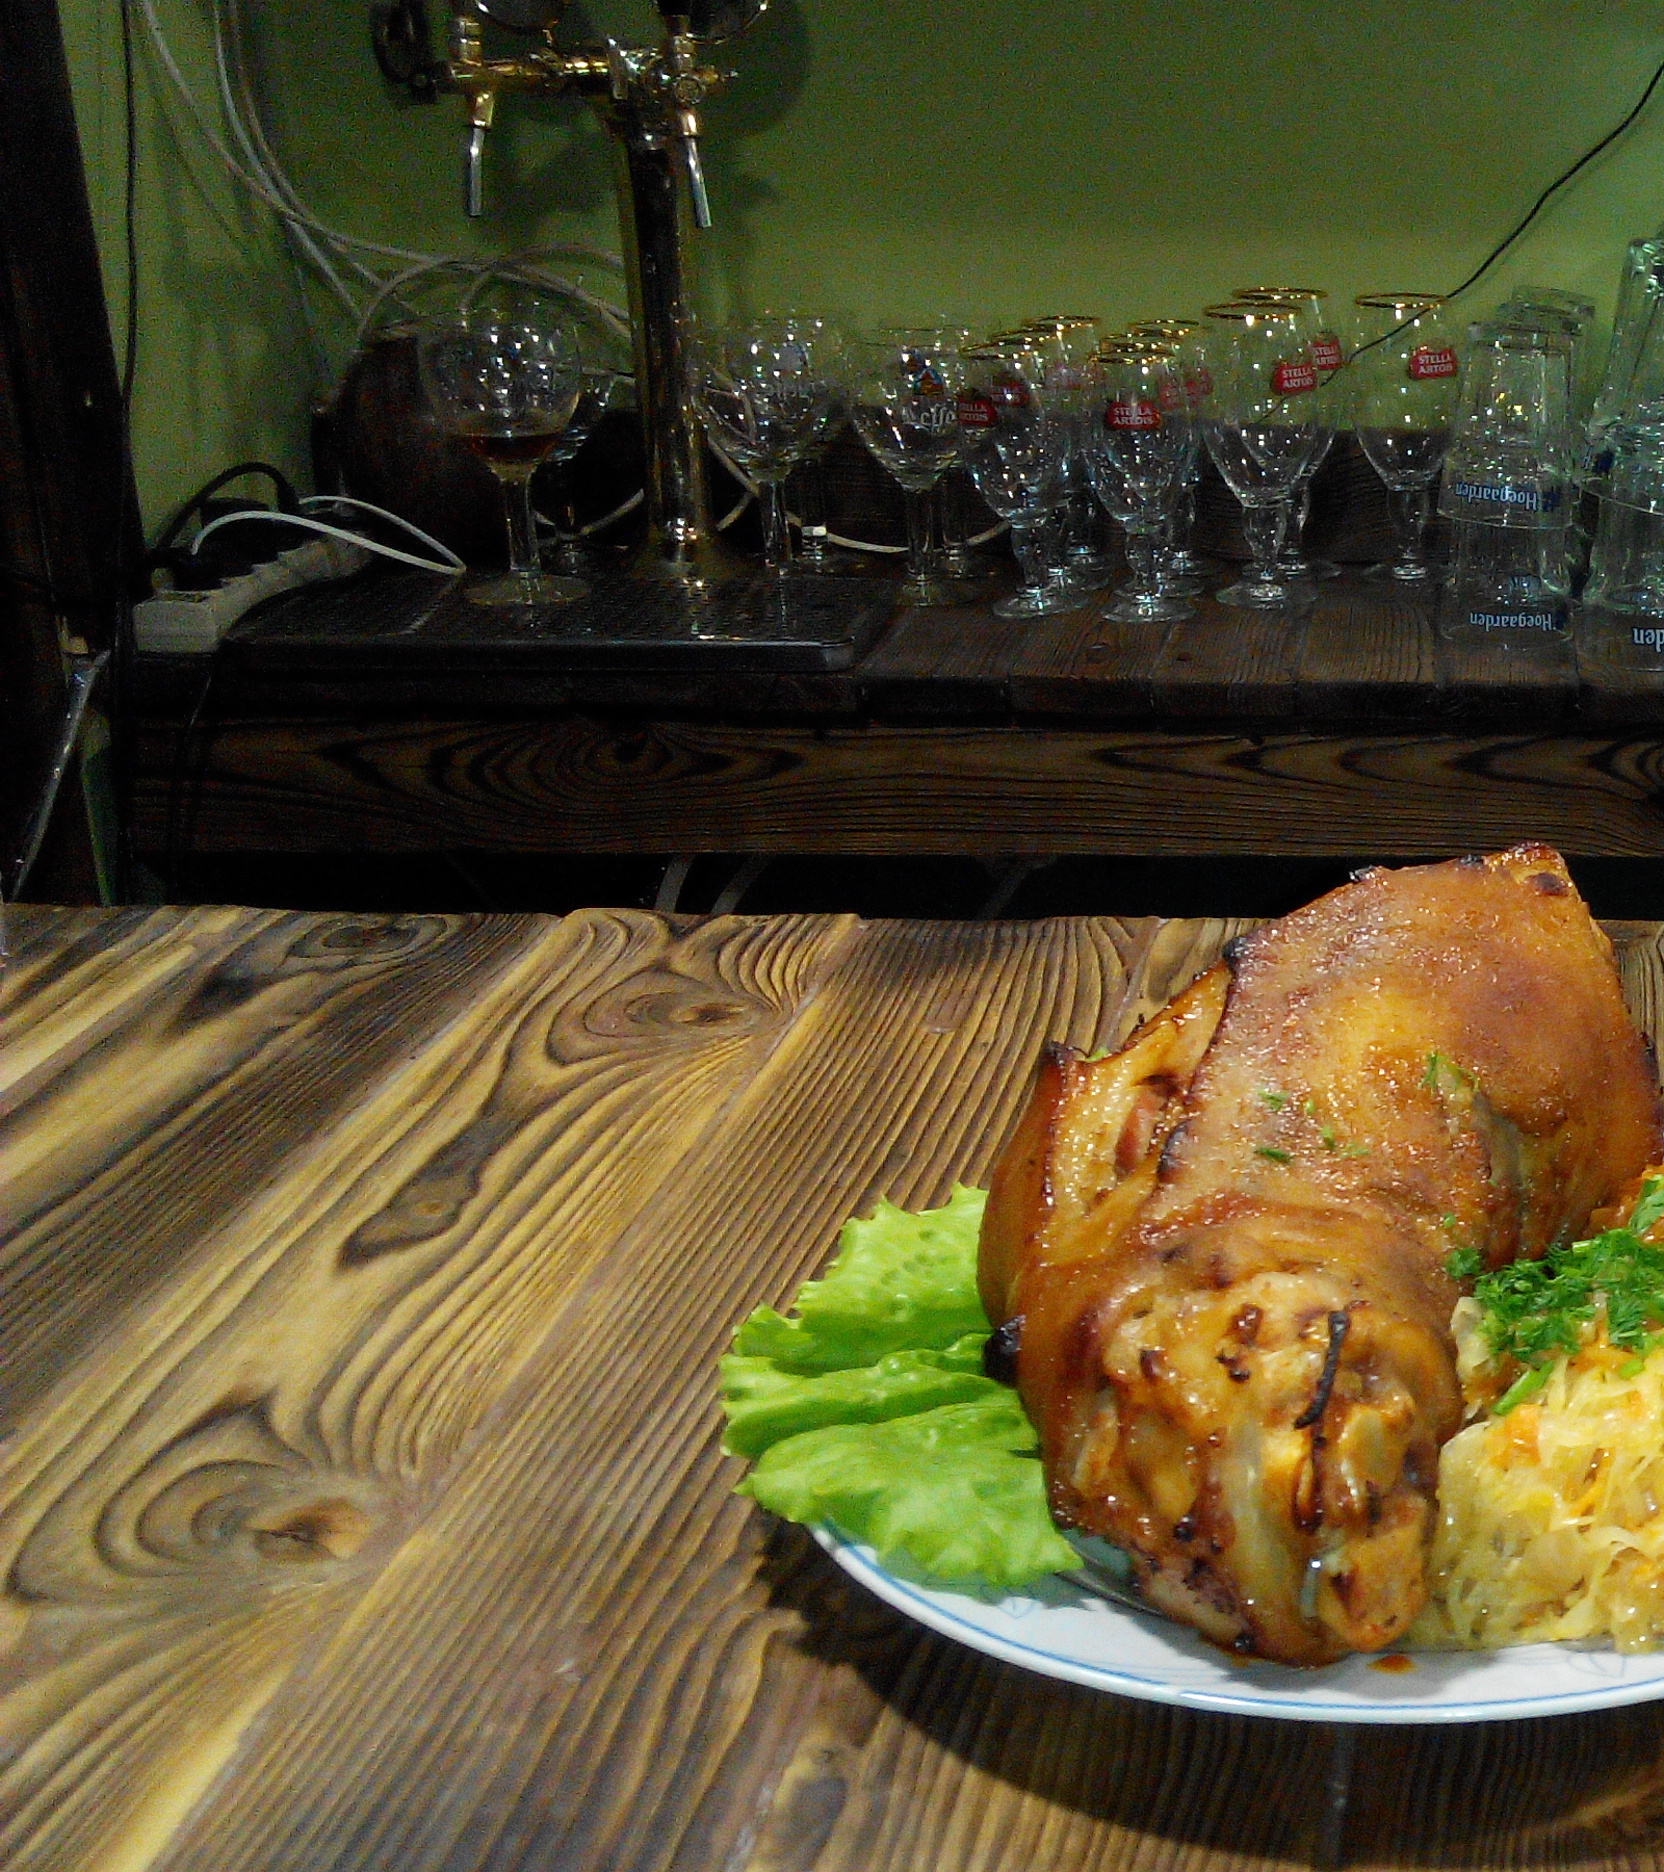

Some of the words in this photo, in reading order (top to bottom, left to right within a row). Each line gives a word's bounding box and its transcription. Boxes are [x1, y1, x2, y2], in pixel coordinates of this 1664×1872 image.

[1418, 353, 1451, 364] STELLA
[1455, 482, 1538, 511] Hoegaarden
[1469, 612, 1553, 633] Hoegaarden
